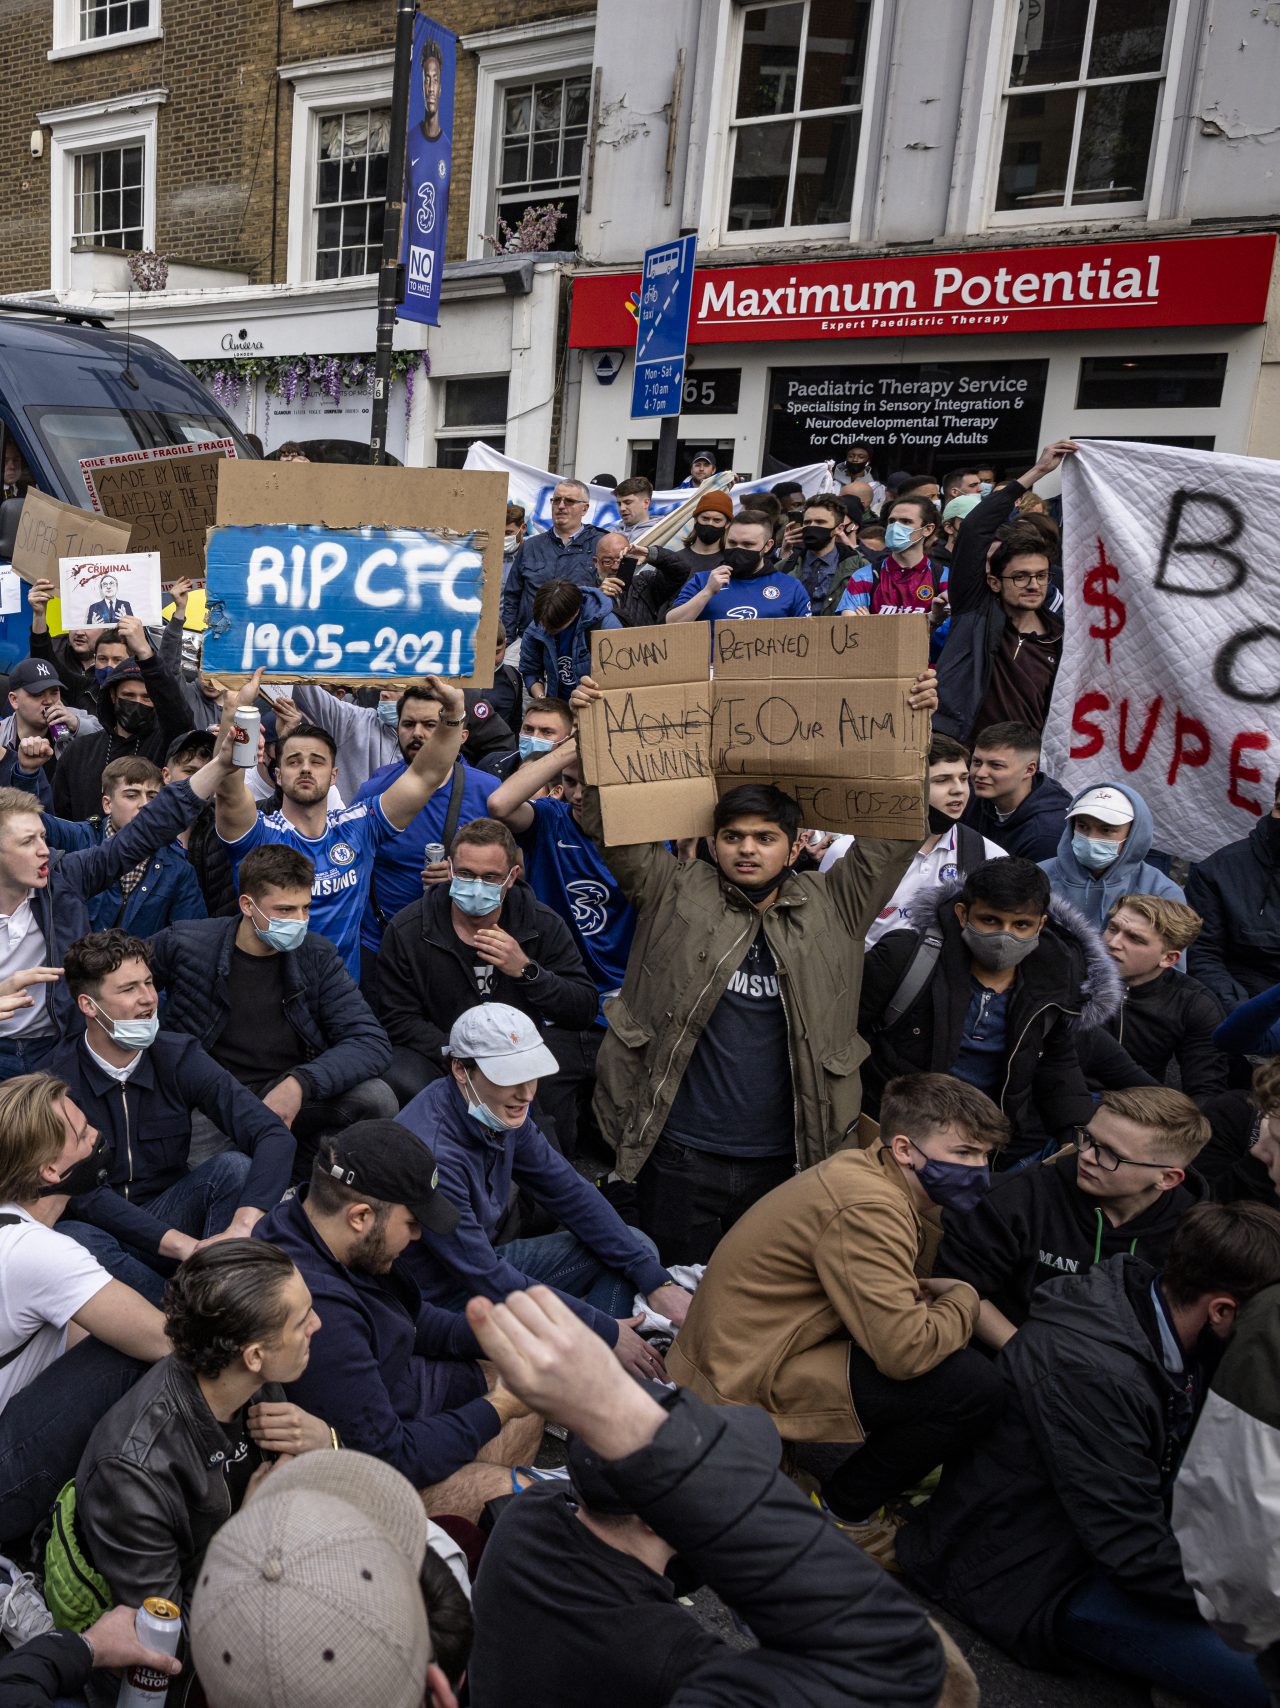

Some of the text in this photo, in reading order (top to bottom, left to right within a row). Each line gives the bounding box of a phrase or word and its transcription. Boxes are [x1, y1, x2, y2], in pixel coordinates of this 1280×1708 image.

[411, 250, 432, 278] NO
[410, 281, 430, 294] TO HATE
[698, 255, 1160, 318] Maximum Potential
[642, 308, 654, 321] taxi
[821, 315, 1010, 331] Expert Paediatric Therapy
[787, 376, 1028, 397] Paediatric Therapy Service
[786, 398, 1024, 414] Specialising in Sensory Integration &
[804, 416, 998, 430] Neurodevelopmental Therapy
[809, 431, 989, 447] for Children & Young Adults
[80, 458, 106, 469] AGILE
[109, 451, 149, 465] FRAGILE
[153, 444, 194, 459] FRAGILE
[98, 468, 145, 493] MADE
[154, 463, 168, 485] BY
[101, 491, 157, 518] PLAYED
[158, 490, 172, 511] BY
[178, 487, 202, 508] THE
[17, 510, 58, 559] SUPER
[170, 538, 196, 558] THE
[87, 563, 132, 574] CRIMINAL
[246, 541, 483, 613] RIP CFC
[241, 622, 463, 675] 1905-2021
[598, 636, 668, 675] ROMAN
[718, 628, 810, 664] BETRAYED
[794, 783, 848, 825] FC
[311, 869, 358, 896] MSUNG
